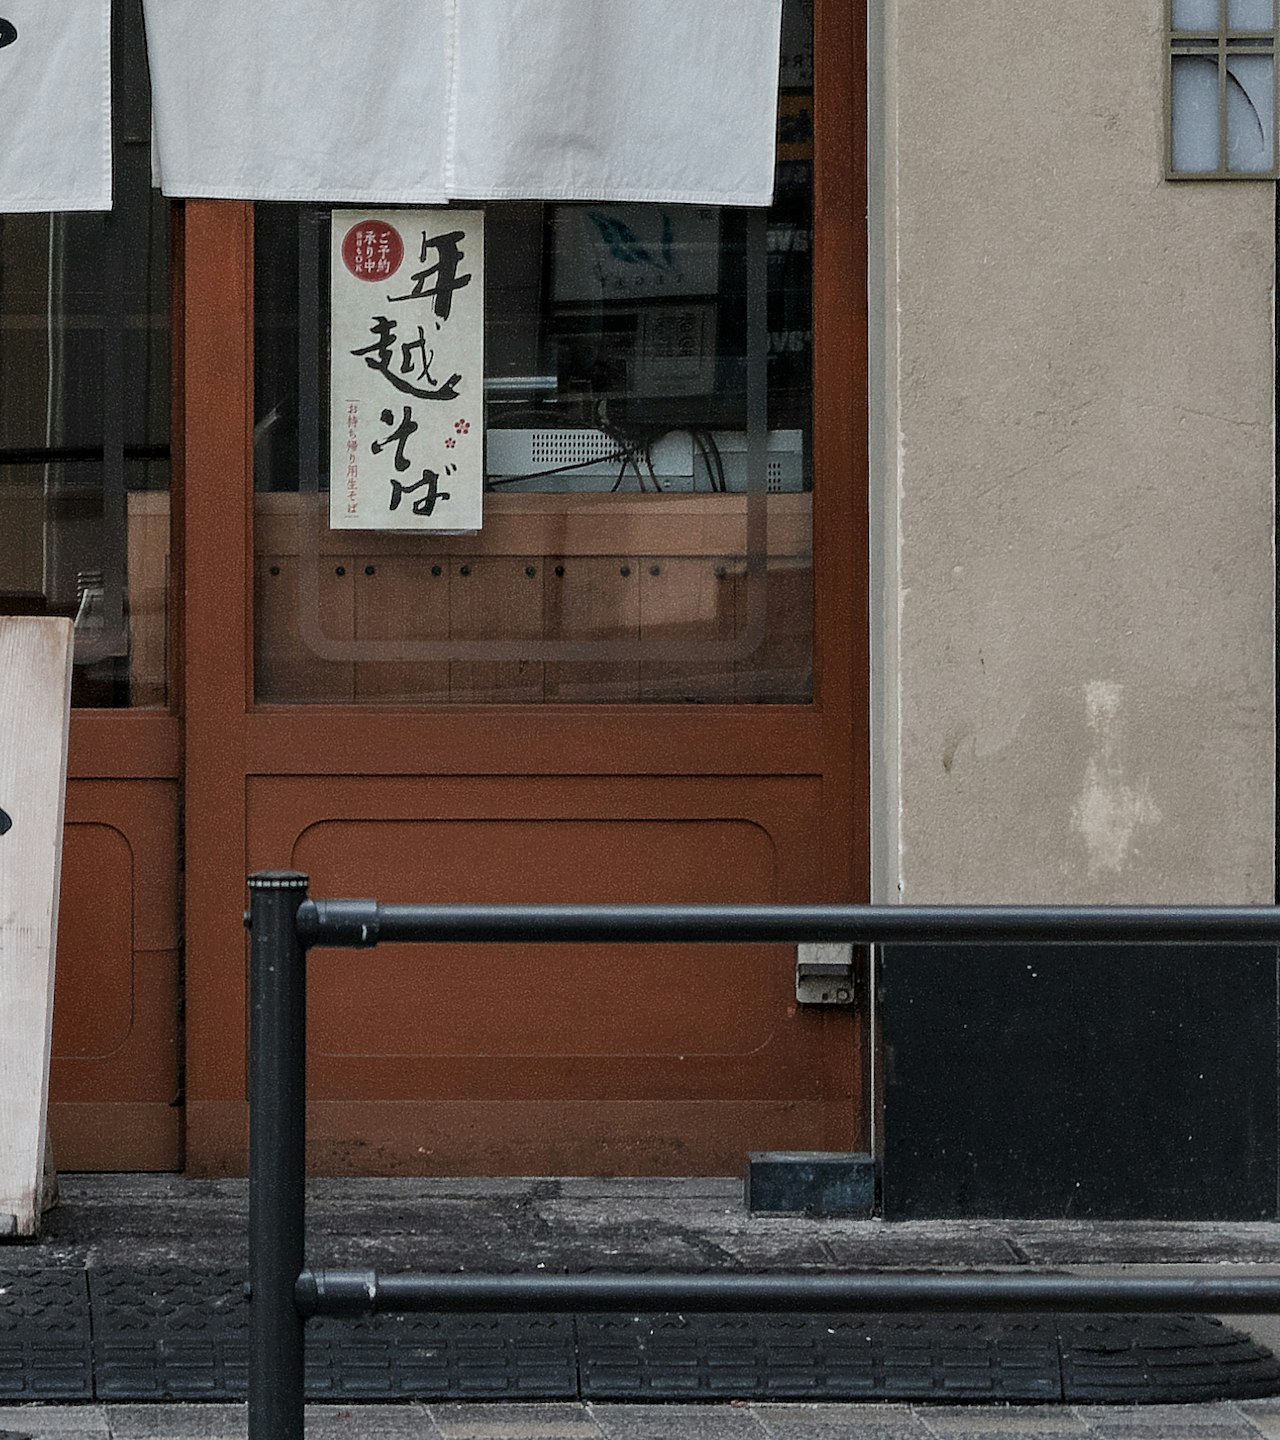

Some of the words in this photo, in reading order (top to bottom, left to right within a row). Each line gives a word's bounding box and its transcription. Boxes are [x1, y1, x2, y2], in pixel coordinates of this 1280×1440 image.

[363, 230, 377, 273] 承り中
[376, 230, 391, 274] ご予約
[350, 230, 472, 517] 年越そば
[346, 403, 358, 513] お持ち帰り用生そば
